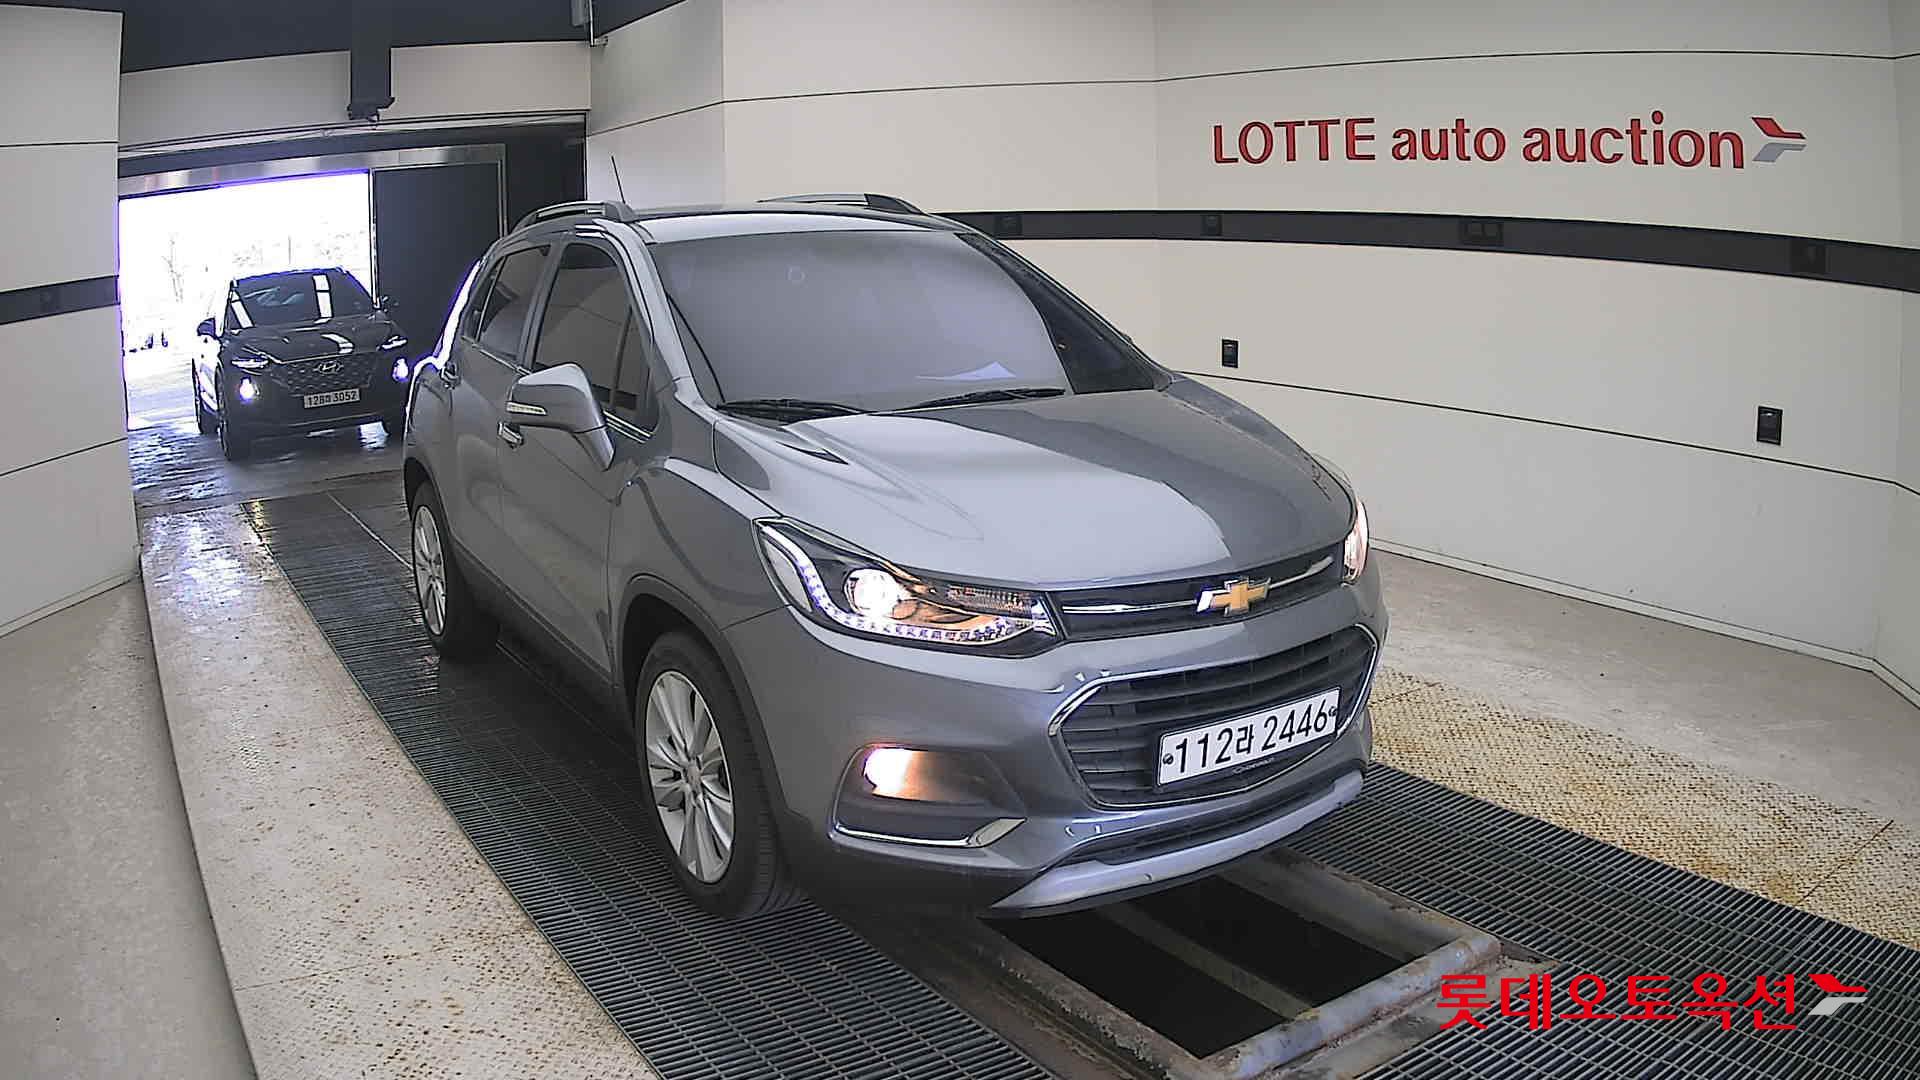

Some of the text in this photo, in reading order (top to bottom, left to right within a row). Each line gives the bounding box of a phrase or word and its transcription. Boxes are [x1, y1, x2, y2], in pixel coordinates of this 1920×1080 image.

[1213, 110, 1745, 169] LOTTE auto auction
[1175, 699, 1328, 773] 112라 2446
